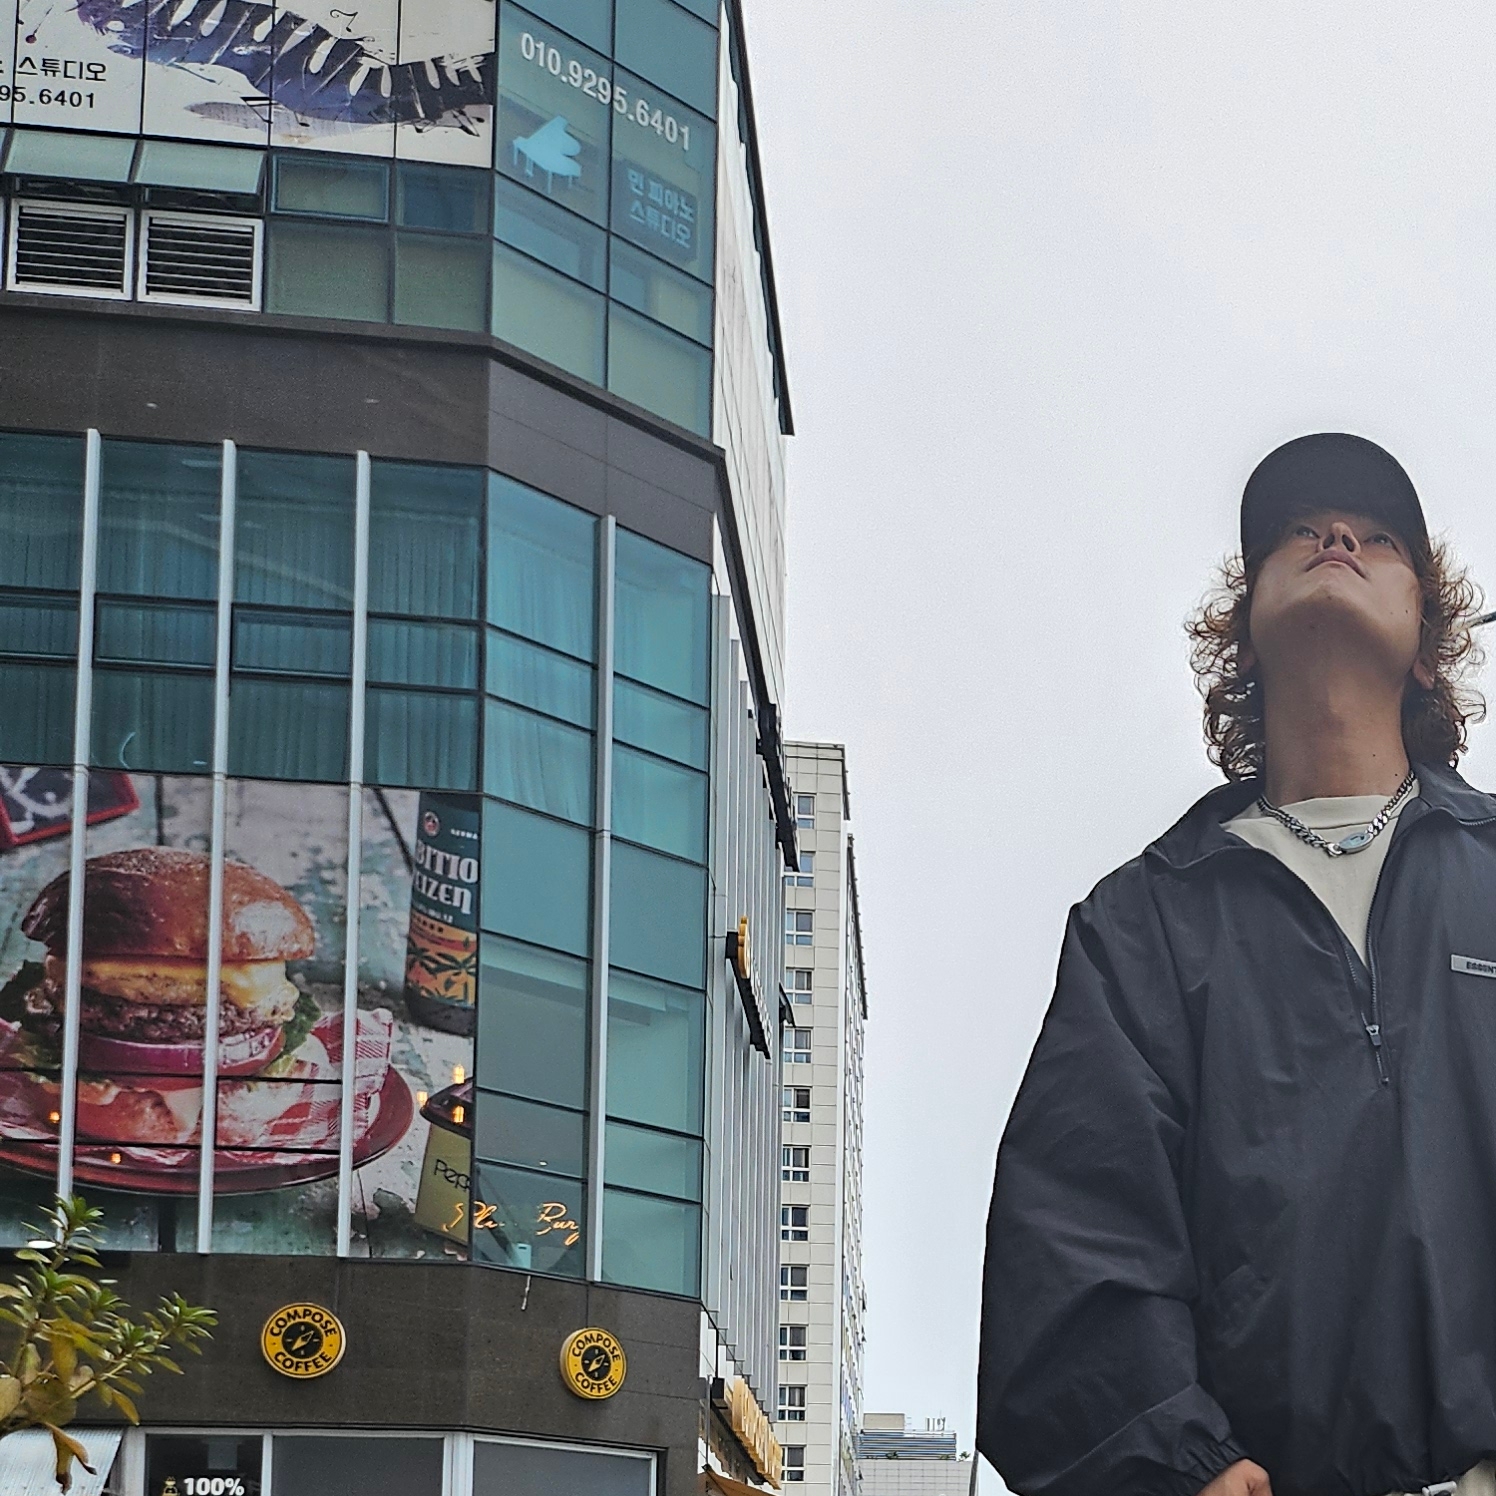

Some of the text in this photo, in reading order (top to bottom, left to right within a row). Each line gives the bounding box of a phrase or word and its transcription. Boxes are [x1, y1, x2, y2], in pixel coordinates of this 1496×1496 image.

[16, 57, 107, 82] 스튜디오
[521, 33, 691, 151] 010.9295.6401
[629, 200, 692, 249] 스튜디오
[269, 1308, 338, 1338] COMPOSE
[572, 1333, 621, 1362] COMPOSE
[274, 1351, 332, 1372] COFFEE
[575, 1372, 617, 1393] COFFEE
[183, 1477, 245, 1496] 100%
